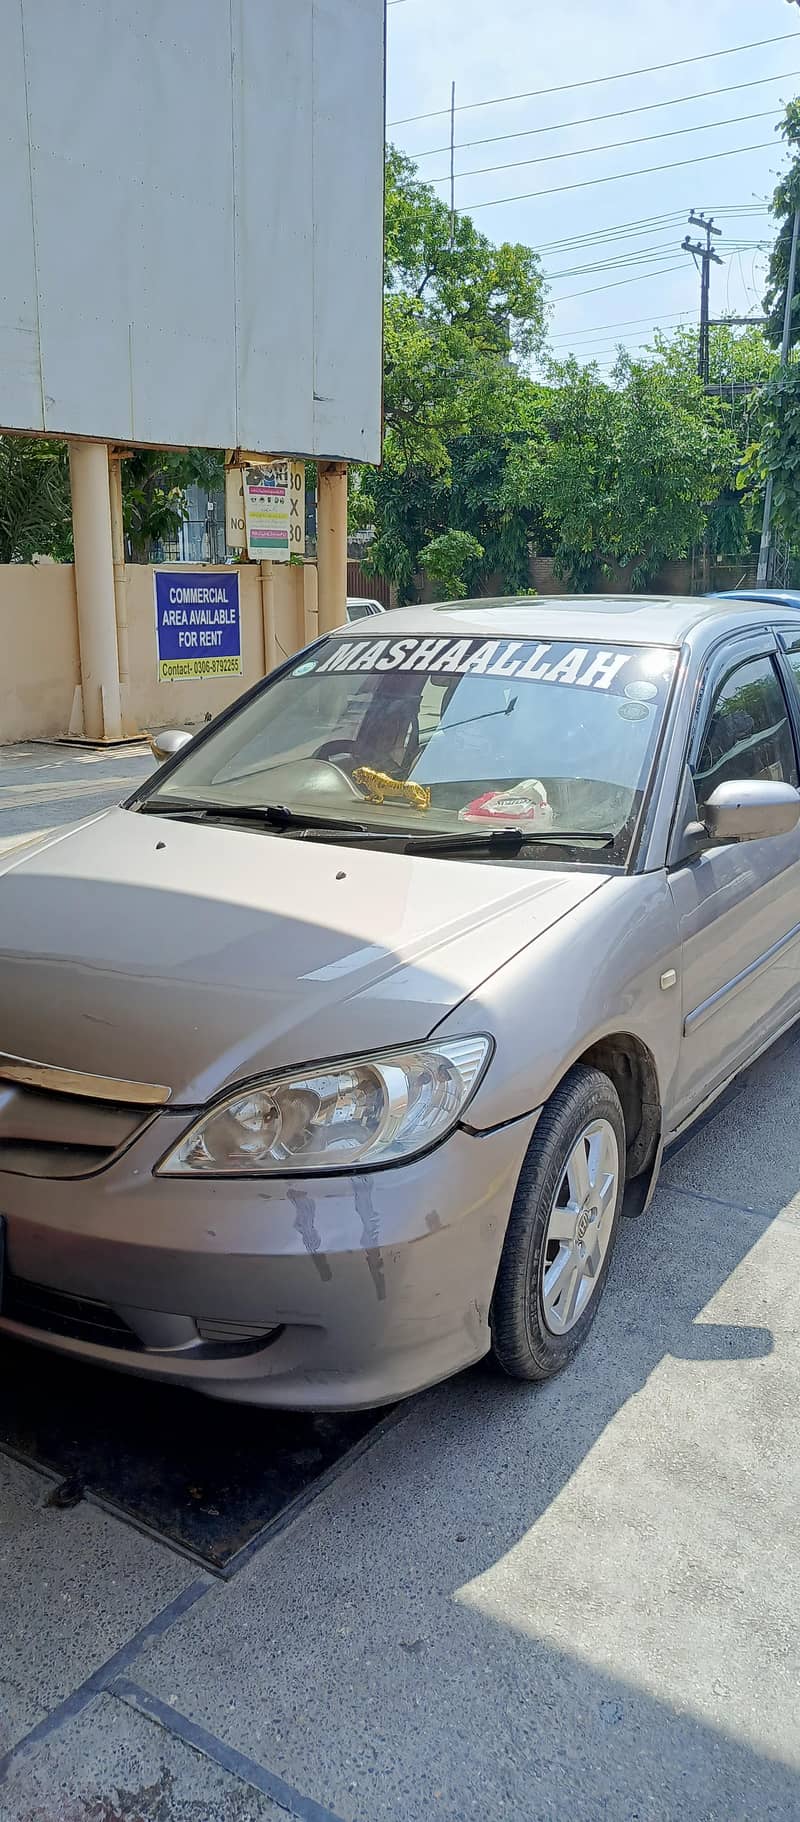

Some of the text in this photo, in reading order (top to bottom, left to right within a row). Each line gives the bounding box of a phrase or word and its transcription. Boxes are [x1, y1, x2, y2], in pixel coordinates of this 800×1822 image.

[169, 587, 229, 604] COMMERCIAL
[162, 608, 236, 626] AREA AVAILABLE
[178, 630, 223, 648] FOR RENT
[315, 638, 632, 690] MASHAALLAH
